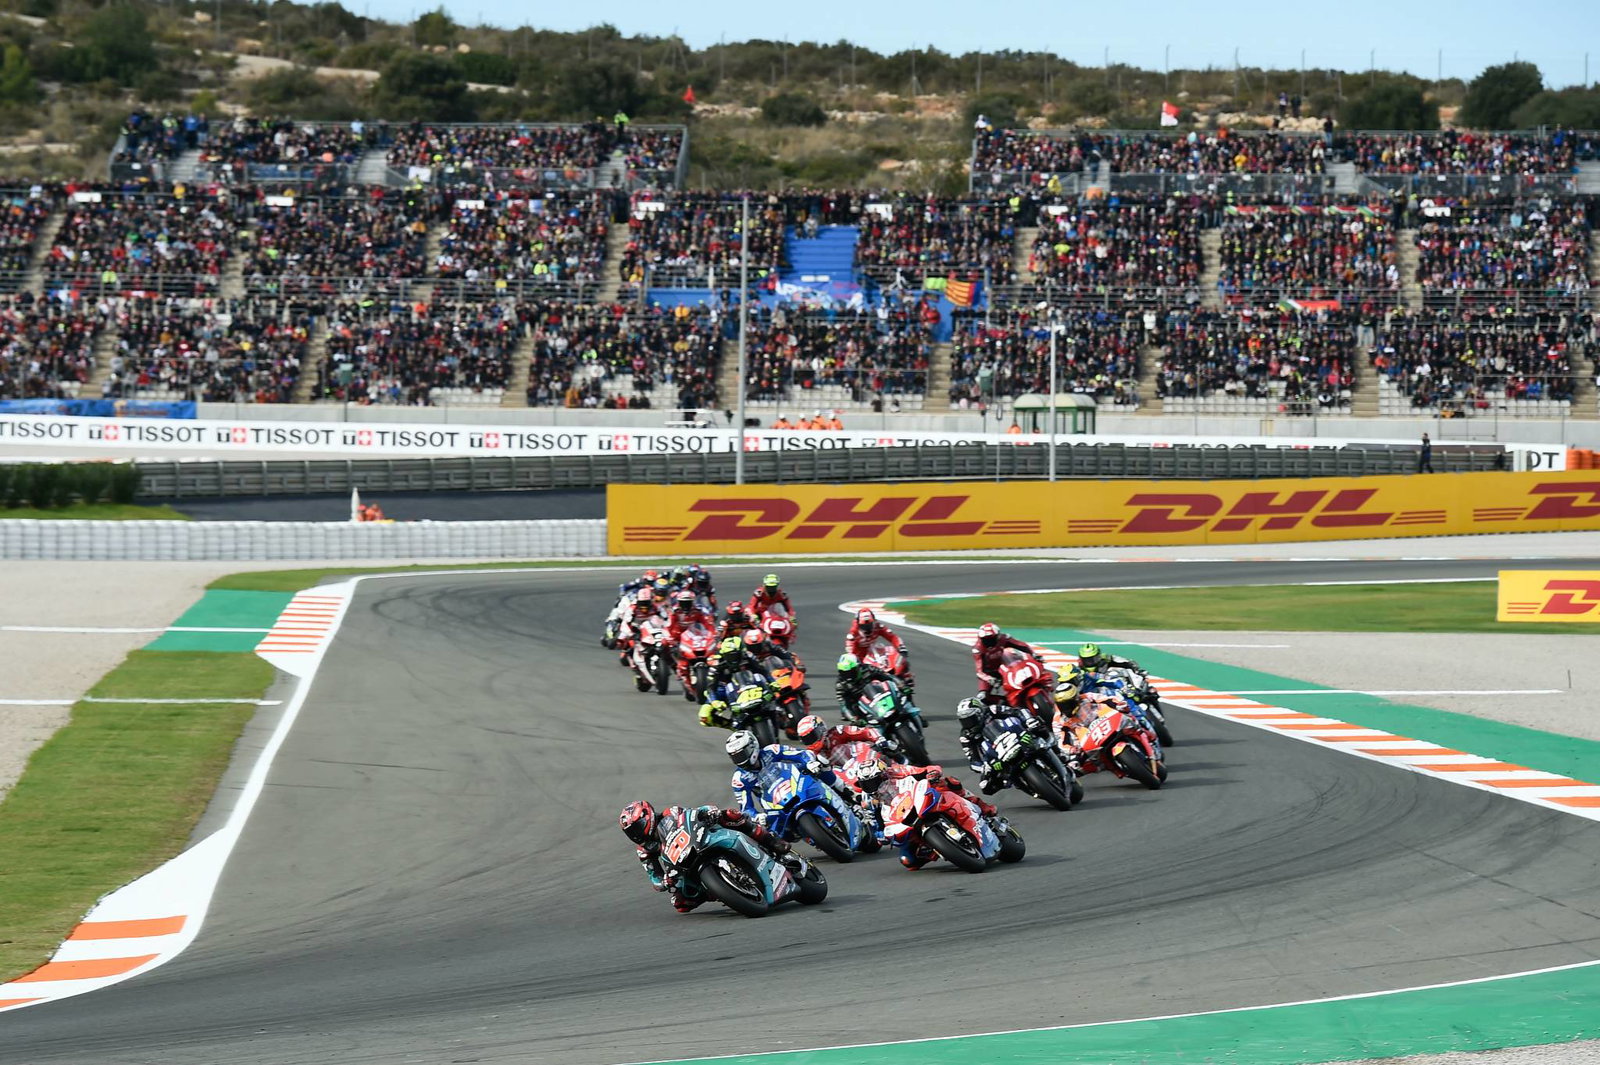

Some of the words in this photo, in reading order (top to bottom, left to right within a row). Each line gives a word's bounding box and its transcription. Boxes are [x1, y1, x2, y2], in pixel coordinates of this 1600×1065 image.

[122, 425, 206, 443] TISSOT
[250, 428, 334, 444] TISSOT
[376, 430, 460, 447] TISSOT
[503, 433, 588, 450] TISSOT
[633, 435, 718, 453] TISSOT
[683, 495, 988, 542] DHL
[1119, 488, 1395, 534] DHL
[1091, 719, 1112, 746] 93
[666, 829, 691, 866] 20
